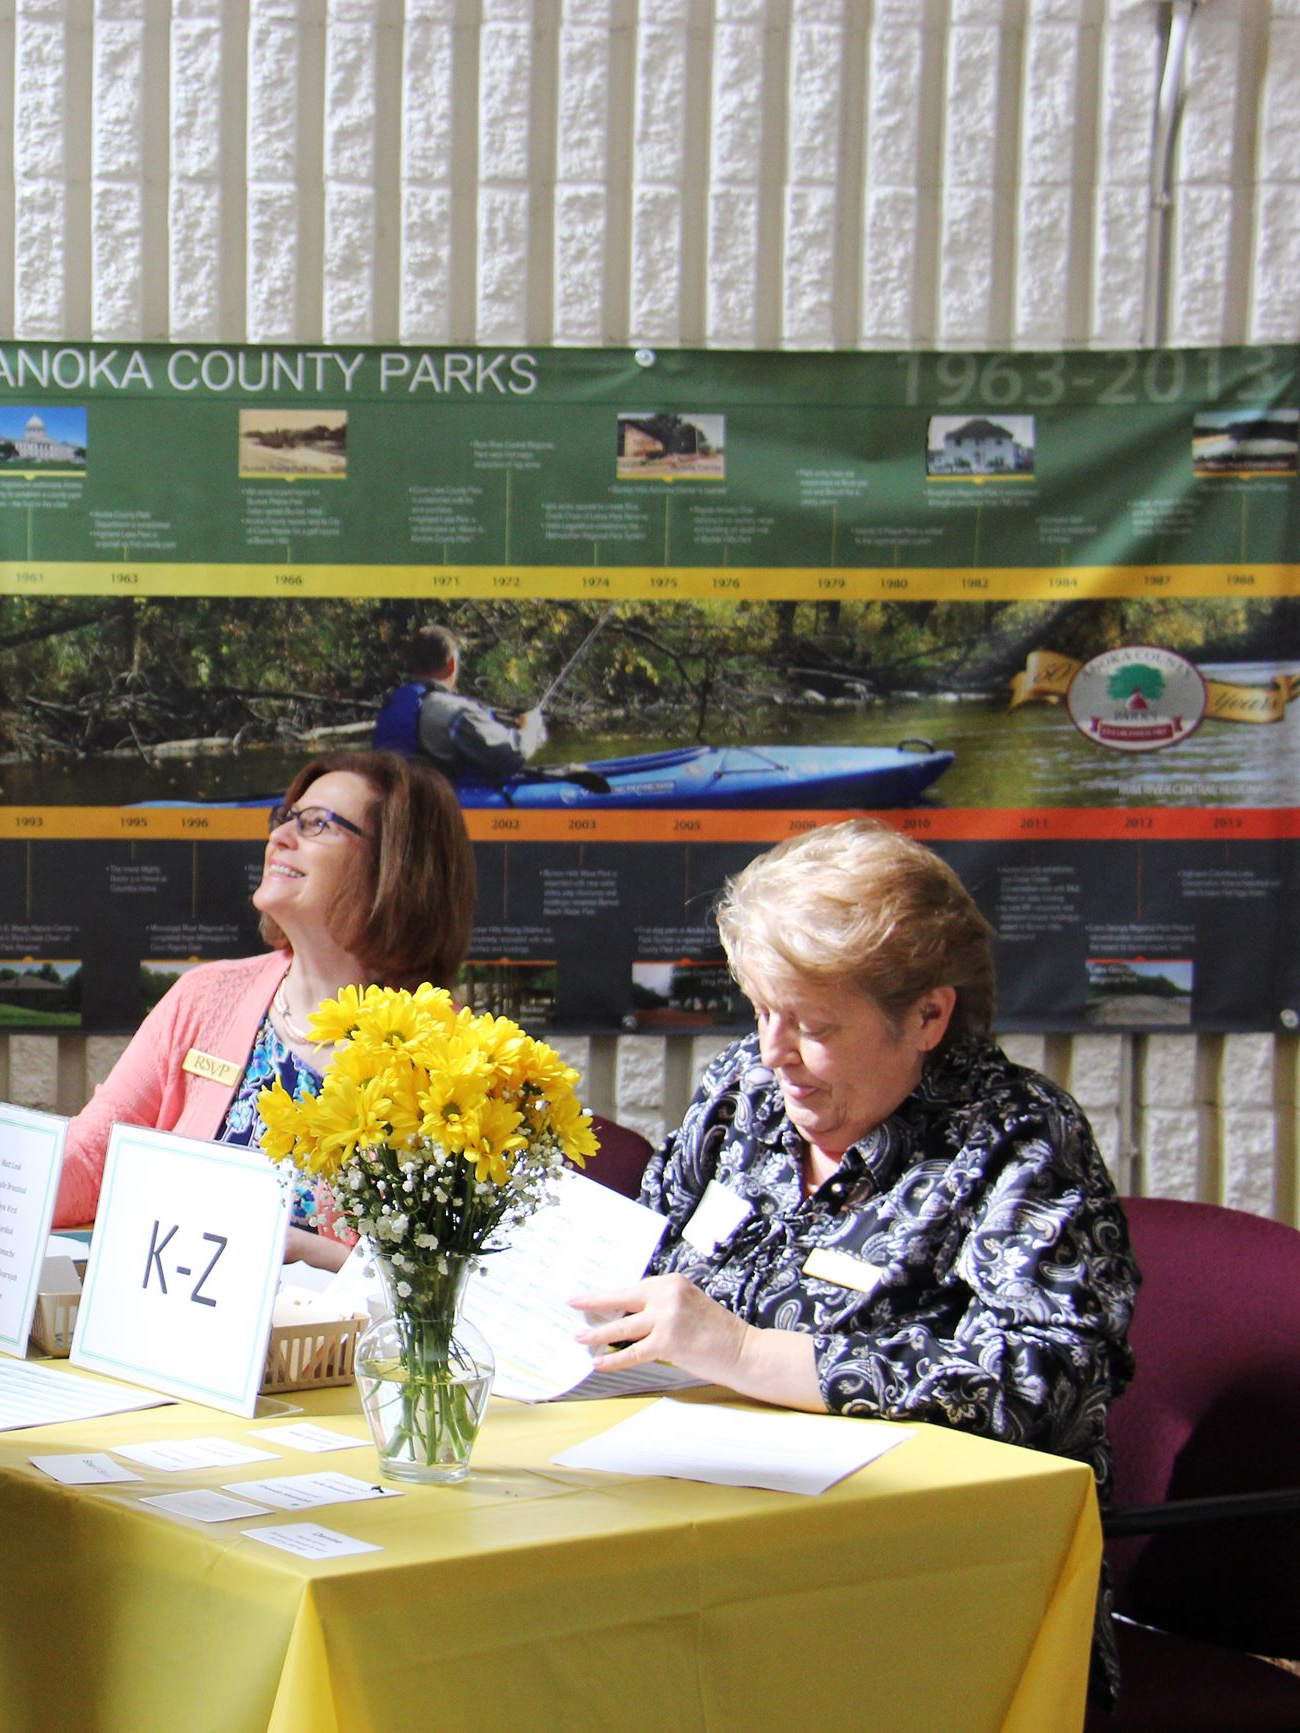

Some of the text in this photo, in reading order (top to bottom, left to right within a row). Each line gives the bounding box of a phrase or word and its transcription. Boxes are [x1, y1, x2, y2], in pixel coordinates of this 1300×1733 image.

[168, 349, 364, 392] COUNTY
[380, 353, 538, 395] PARKS
[896, 349, 1277, 407] 1963-2013
[110, 573, 138, 584] 1963
[274, 574, 302, 586] 1966
[433, 576, 459, 587] 1971
[492, 577, 520, 587] 1972
[582, 577, 609, 588] 1974
[650, 577, 678, 588] 1975
[713, 578, 739, 588] 1976
[818, 578, 845, 589] 1979
[881, 579, 907, 589] 1980
[961, 578, 988, 588] 1982
[1049, 577, 1077, 588] 1984
[1144, 576, 1170, 586] 1987
[15, 817, 208, 828] 1993 1995 1996
[492, 820, 520, 830] 2002
[568, 820, 596, 830] 2003
[673, 820, 701, 830] 2005
[1021, 817, 1048, 829] 2011
[1125, 817, 1153, 829] 2012
[1213, 817, 1241, 828] 2013
[194, 1054, 230, 1078] RSVP
[142, 1220, 228, 1308] K-Z
